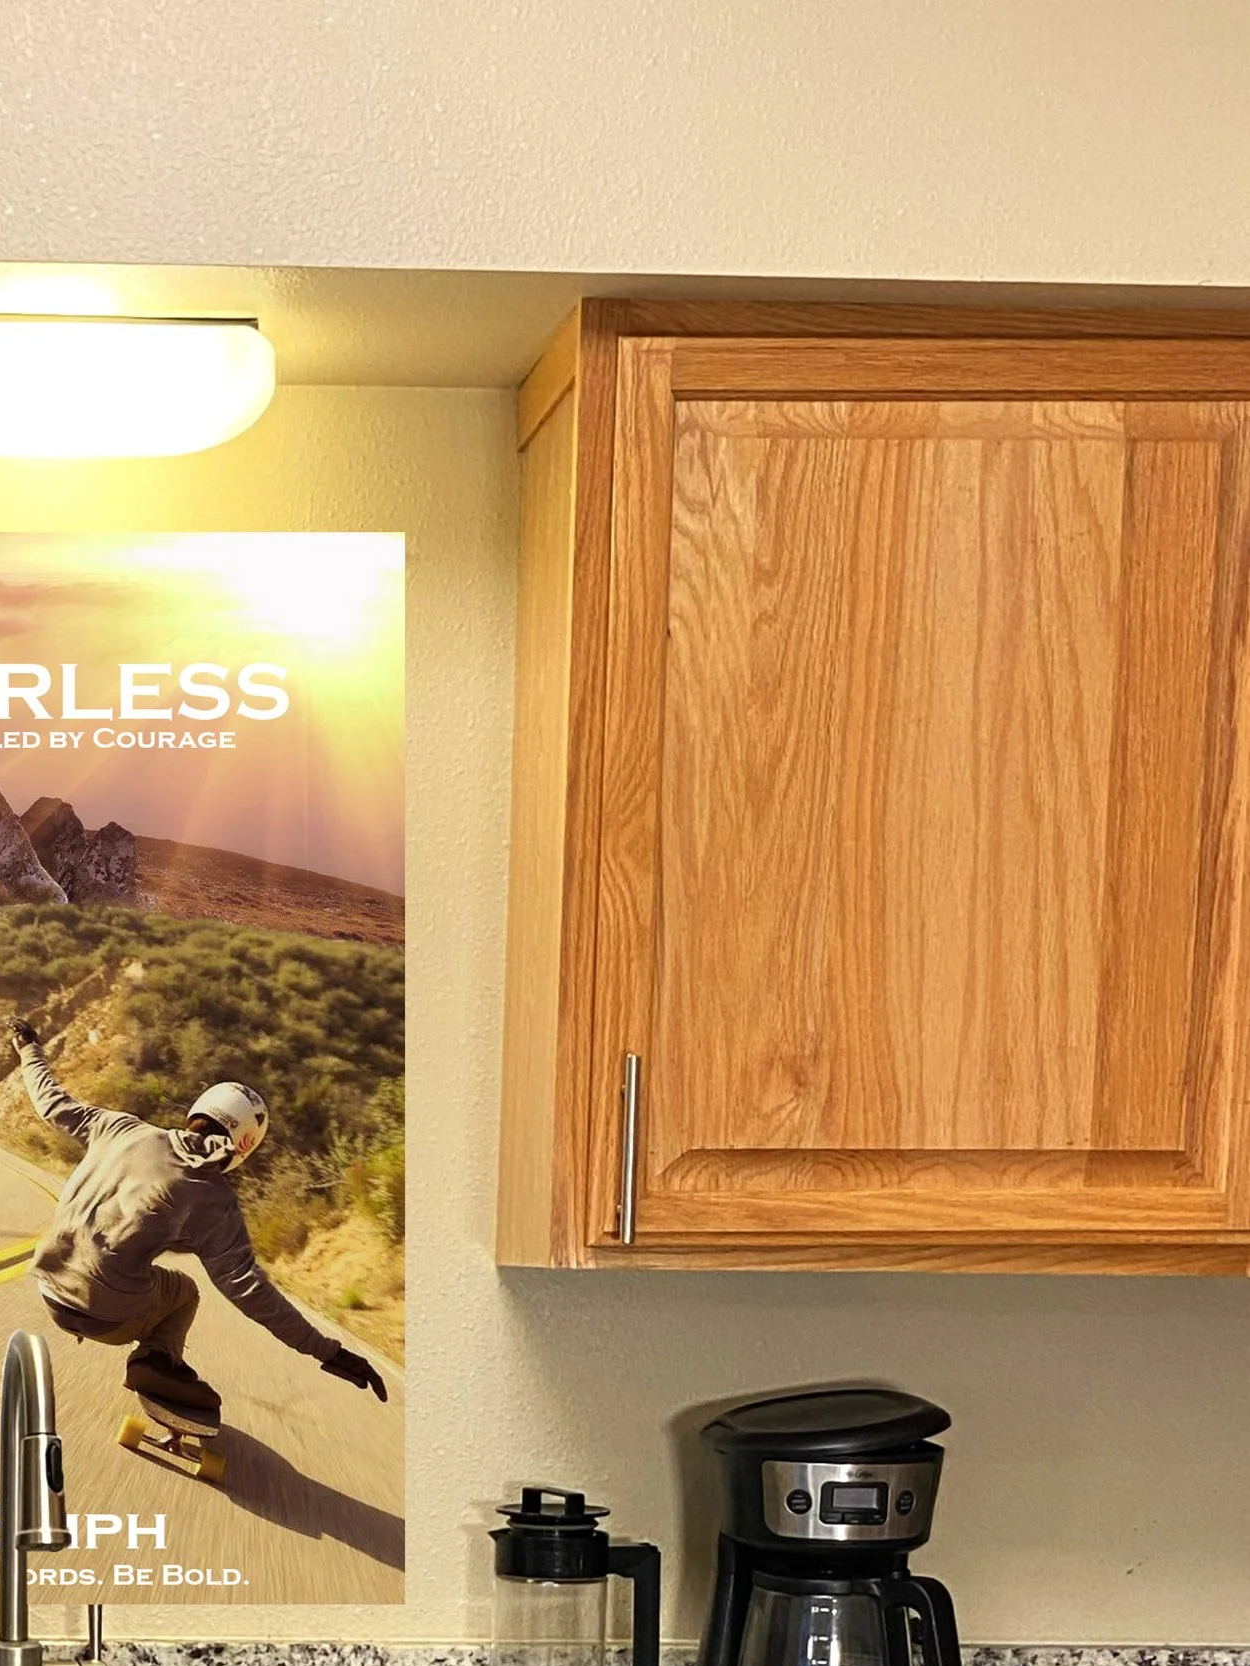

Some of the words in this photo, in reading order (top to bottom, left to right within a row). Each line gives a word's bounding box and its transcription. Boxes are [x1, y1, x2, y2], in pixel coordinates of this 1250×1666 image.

[71, 1513, 167, 1551] PH
[113, 1564, 154, 1586] BE
[162, 1564, 250, 1586] BOLD.
